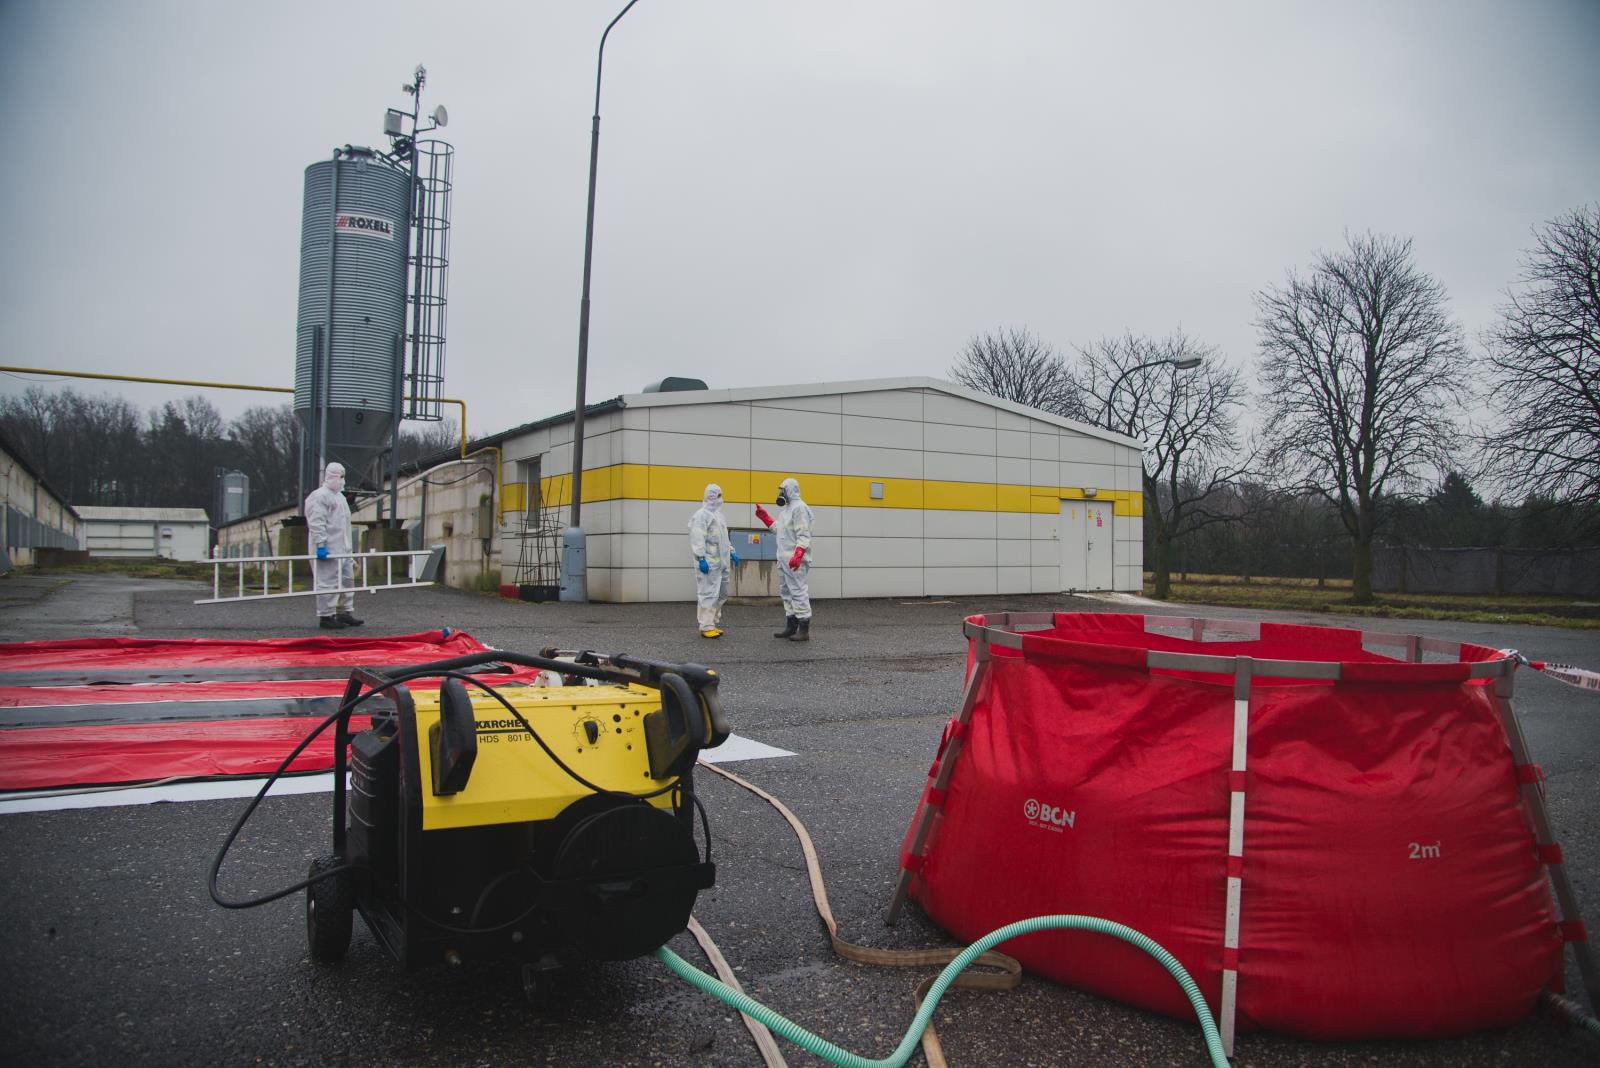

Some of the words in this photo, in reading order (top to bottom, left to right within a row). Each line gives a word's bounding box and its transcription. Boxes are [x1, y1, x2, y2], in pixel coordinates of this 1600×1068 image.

[348, 216, 391, 234] ROXELL
[355, 411, 364, 424] 9
[479, 735, 500, 744] HDS
[507, 734, 522, 742] 801
[524, 733, 531, 742] B
[1040, 803, 1076, 829] BCN
